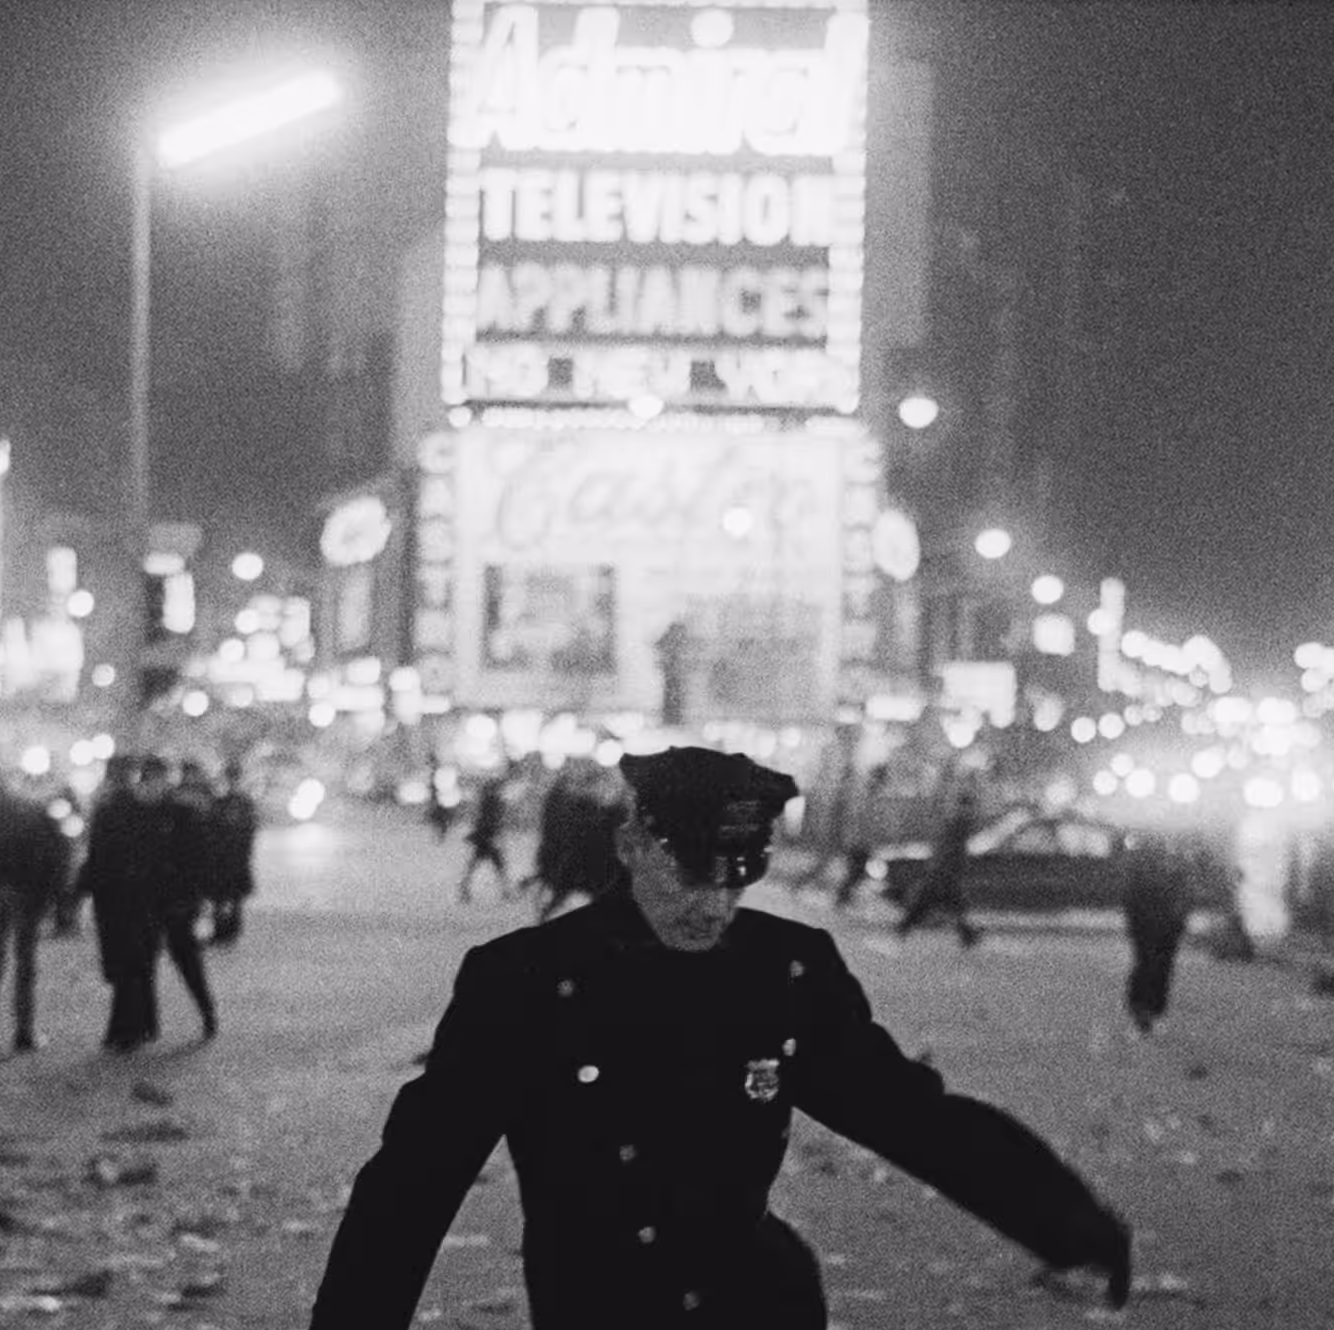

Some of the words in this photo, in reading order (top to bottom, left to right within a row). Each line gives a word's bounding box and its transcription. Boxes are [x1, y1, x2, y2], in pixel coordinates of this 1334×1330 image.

[452, 4, 869, 156] Admiral
[478, 168, 840, 246] TELEVISION
[476, 265, 833, 334] APPLIANCES
